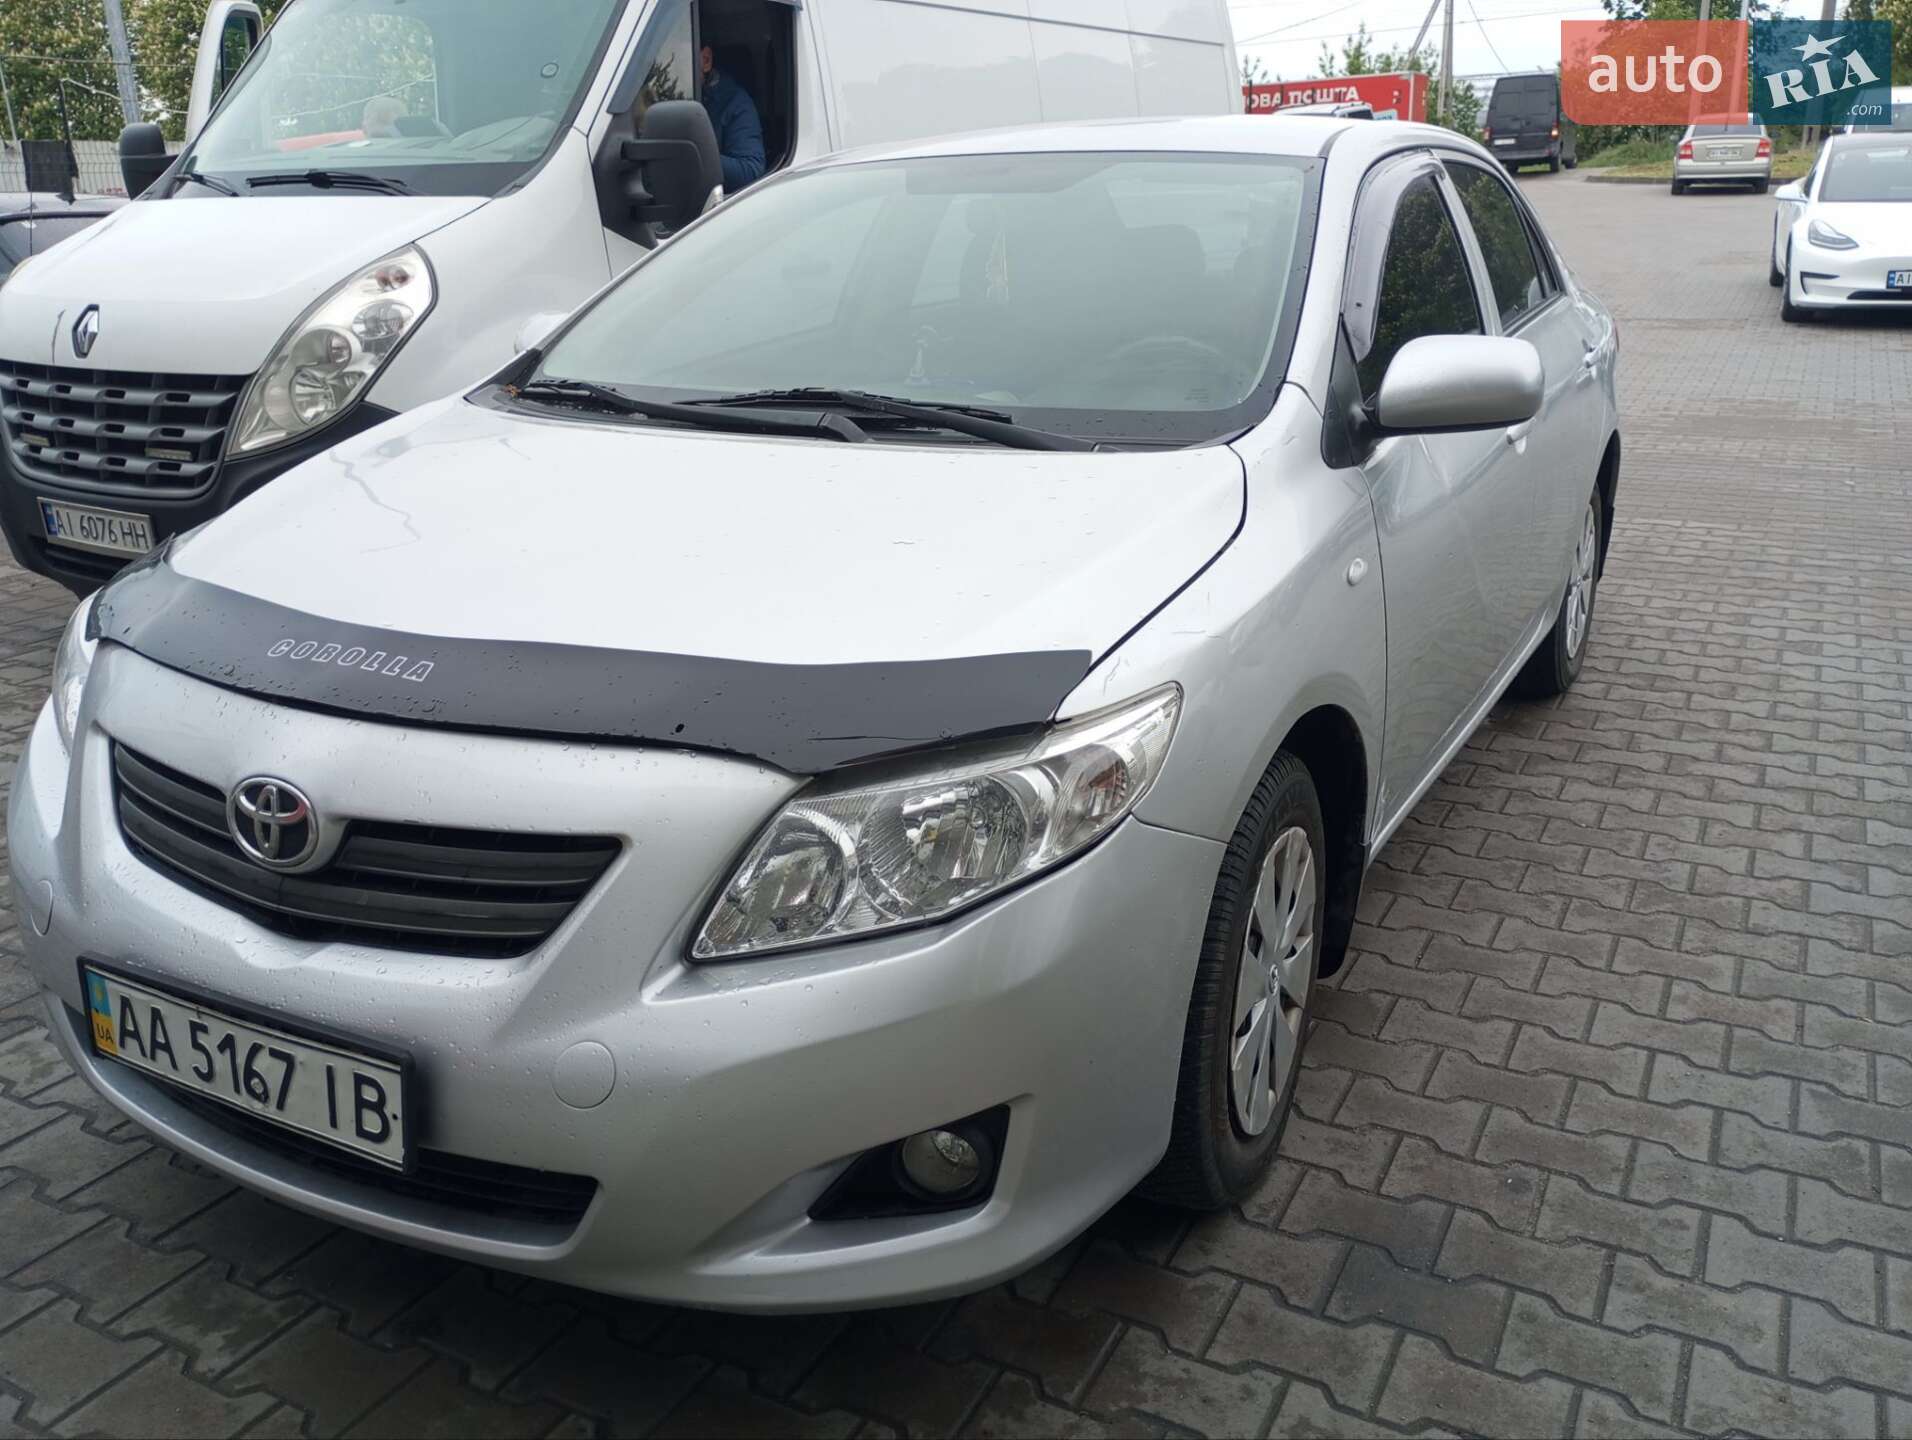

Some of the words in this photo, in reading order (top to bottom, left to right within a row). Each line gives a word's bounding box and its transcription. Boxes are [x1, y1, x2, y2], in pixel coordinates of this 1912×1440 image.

[1243, 92, 1282, 109] ОВА
[55, 509, 74, 537] AI
[80, 514, 118, 544] 6076
[119, 520, 150, 550] HH
[267, 639, 434, 682] COROLLA
[119, 994, 179, 1071] AA
[189, 1019, 296, 1112] 5167
[326, 1063, 391, 1143] IB
